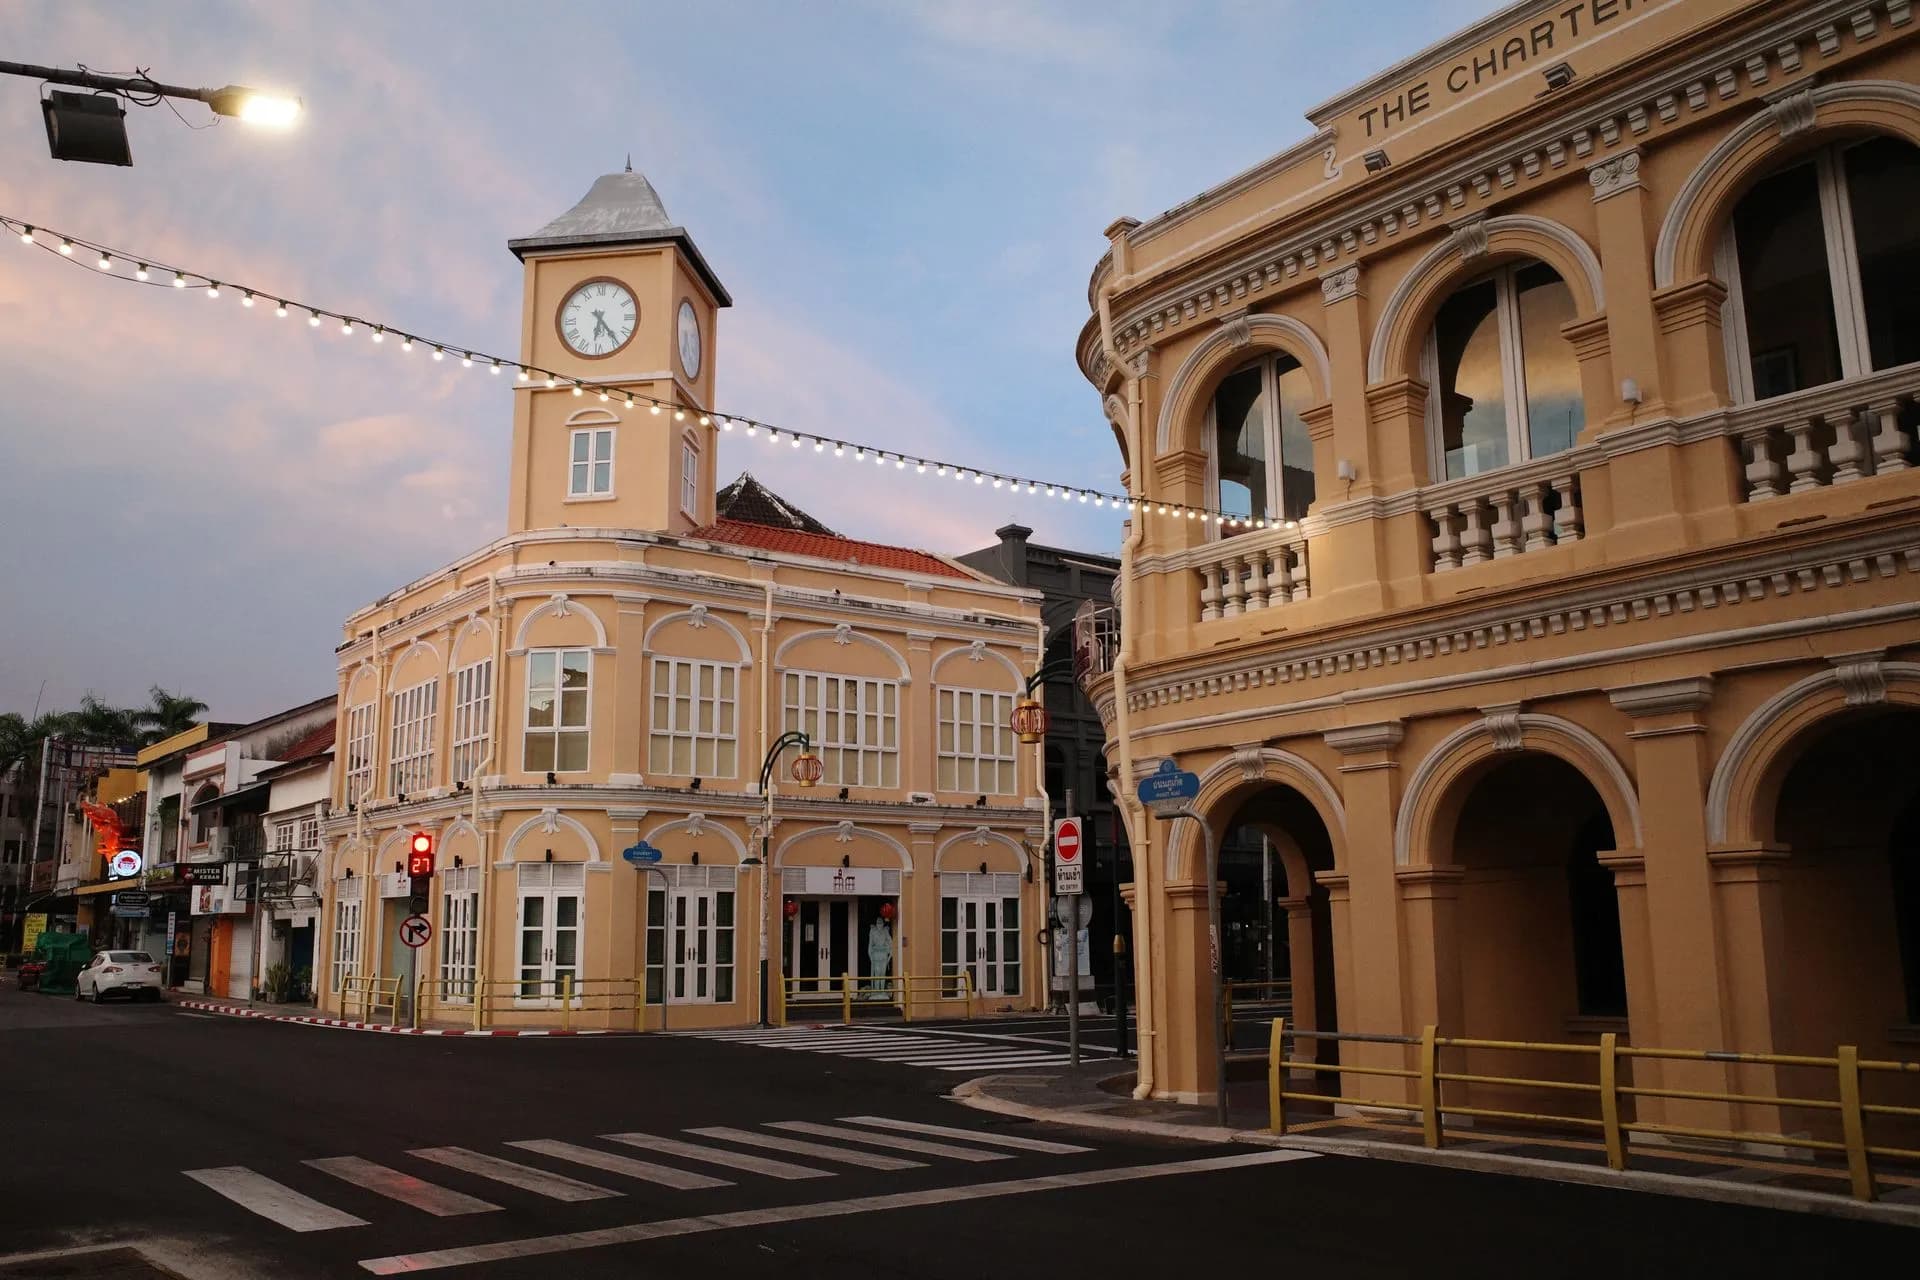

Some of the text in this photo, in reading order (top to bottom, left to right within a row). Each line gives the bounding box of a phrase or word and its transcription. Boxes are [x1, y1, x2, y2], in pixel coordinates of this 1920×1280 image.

[1358, 82, 1430, 137] THE
[412, 858, 430, 873] 27
[1057, 866, 1081, 881] ห้ามเข้า
[1066, 883, 1079, 891] ENTRY
